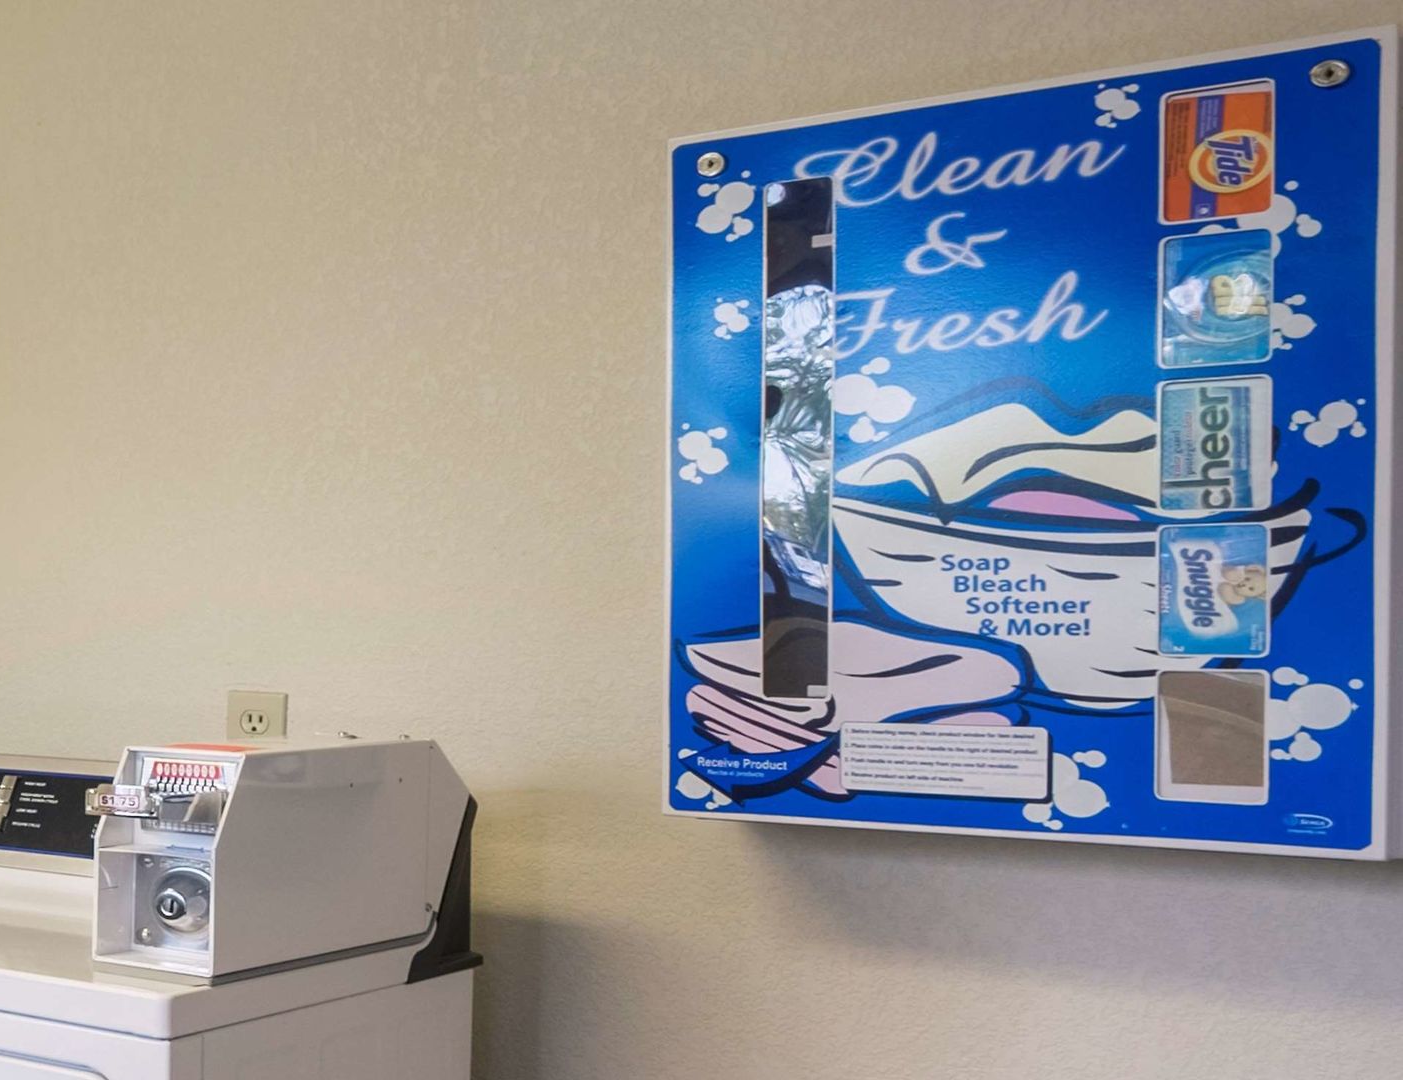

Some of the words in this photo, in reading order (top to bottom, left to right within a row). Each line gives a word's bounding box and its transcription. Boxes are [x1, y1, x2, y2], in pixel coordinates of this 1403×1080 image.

[794, 132, 1126, 207] Clean
[1205, 135, 1254, 186] Tide
[905, 212, 1008, 275] &
[833, 270, 1108, 360] Fresh
[1160, 386, 1232, 509] cheer
[940, 554, 1011, 575] Soap
[953, 574, 1047, 593] Bleach
[1179, 547, 1222, 628] Snuggle
[965, 596, 1091, 615] Softener
[978, 618, 999, 636] &
[1006, 618, 1091, 636] More!
[697, 756, 740, 769] Receive
[742, 758, 788, 771] Product
